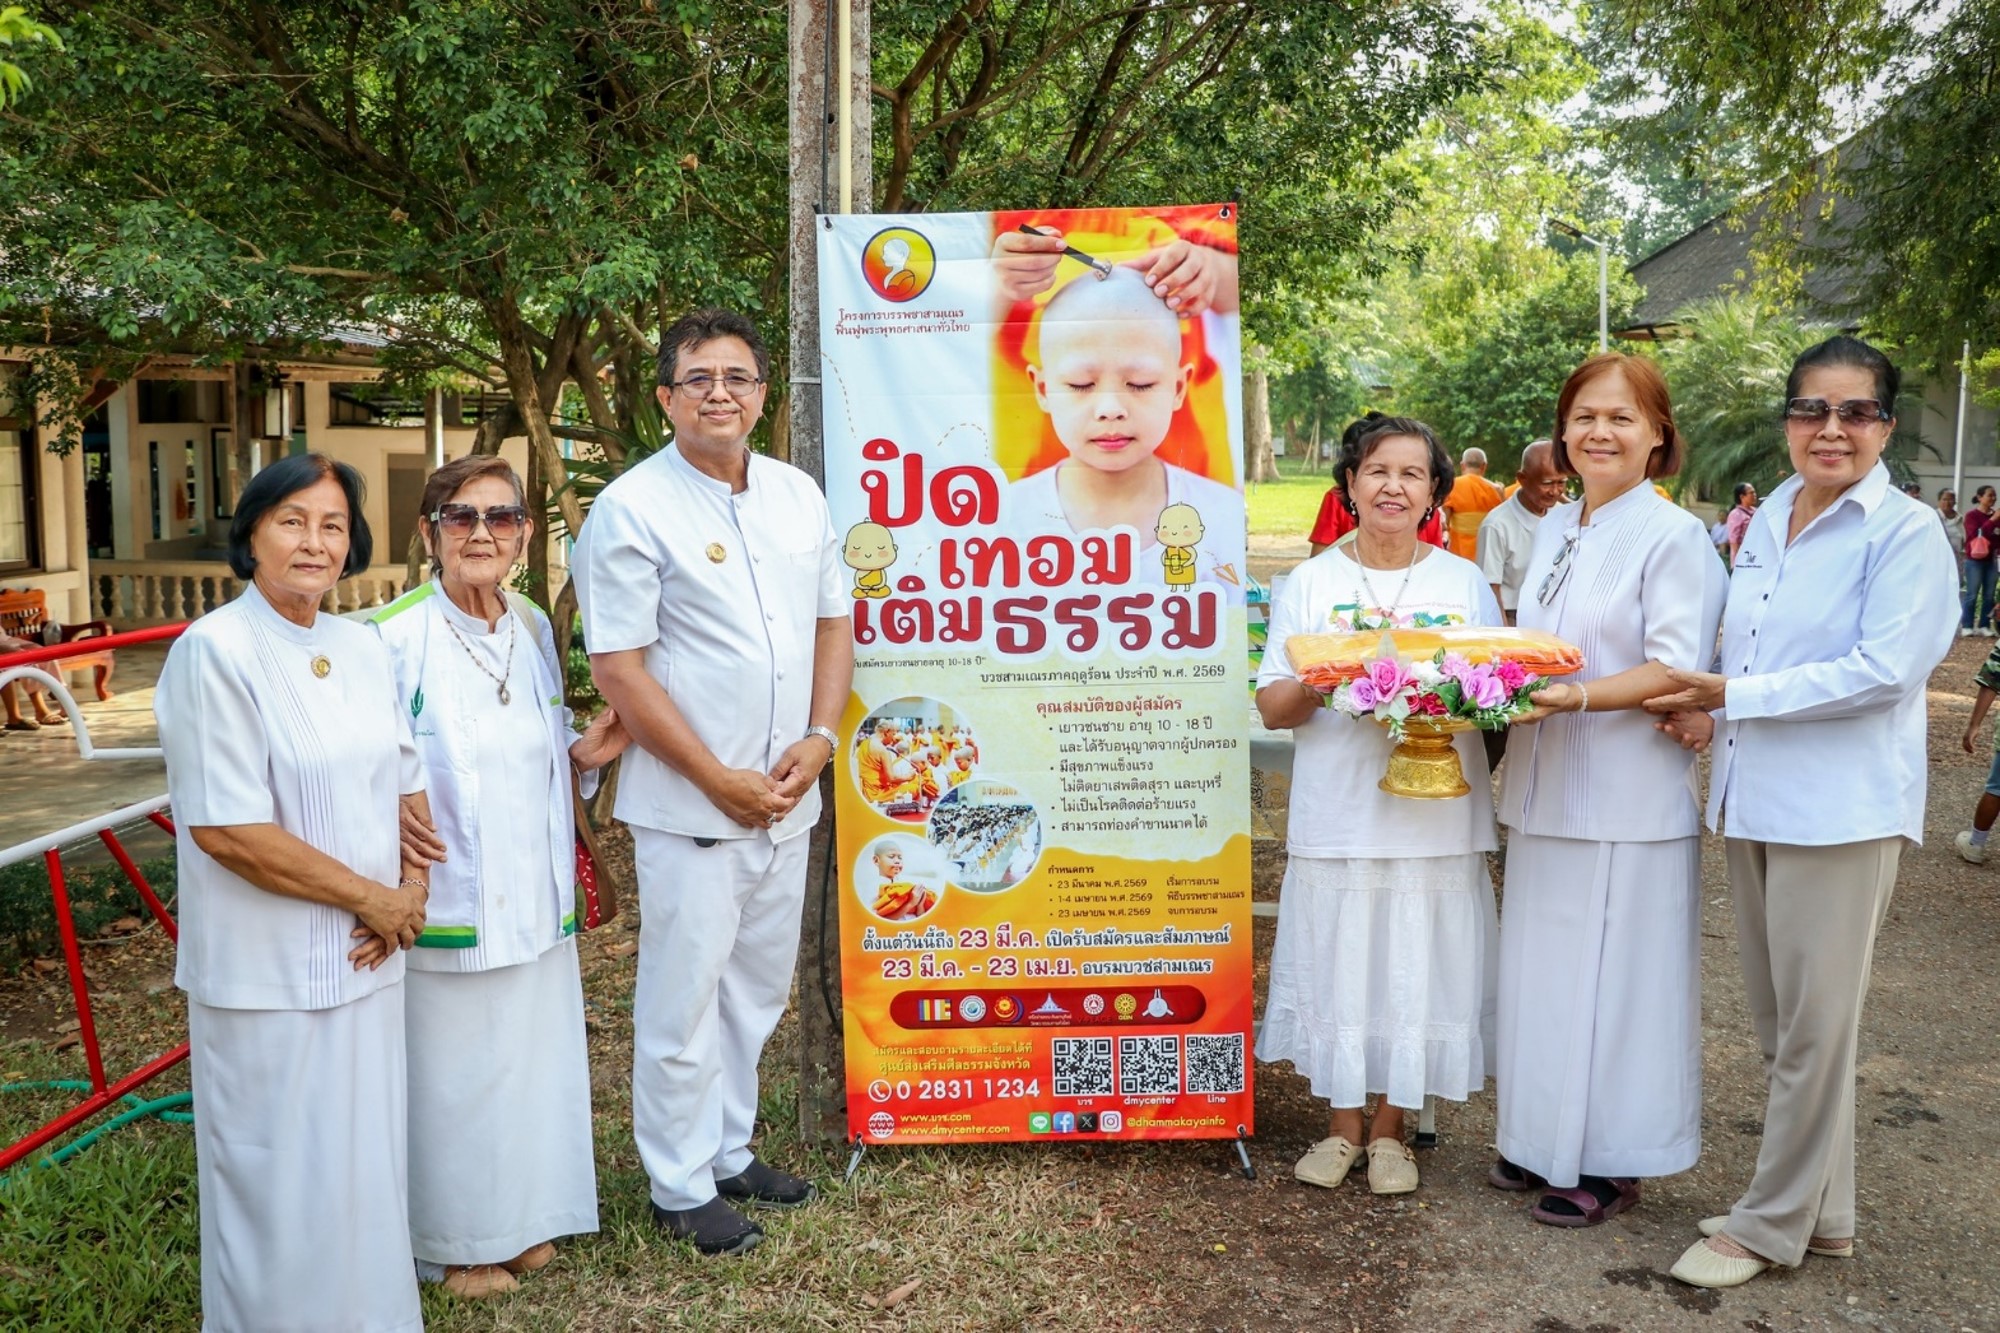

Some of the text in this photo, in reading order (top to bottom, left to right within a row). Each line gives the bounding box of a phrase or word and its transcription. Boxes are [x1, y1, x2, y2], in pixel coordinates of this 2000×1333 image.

[860, 438, 999, 528] ปิด
[939, 533, 1131, 589] เทอม
[948, 657, 972, 666] 10-18
[980, 665, 1225, 685] บวชสามเณรภาคฤดูร้อน ประจำปี พ.ศ. 2569
[1036, 695, 1182, 717] คุณสมบัติของผู้สมัคร
[1059, 721, 1125, 733] เยาวชนชาย
[1129, 720, 1152, 734] อายุ
[1158, 719, 1171, 730] 10
[1186, 719, 1199, 730] 18
[1060, 757, 1154, 775] มีสุขภาพแข็งแรง
[1060, 772, 1222, 794] ไม่ติดยาเสพติดสุรา และบุหรี่
[1060, 796, 1196, 813] ไม่เป็นโรคติดต่อร้ายแรง
[1061, 813, 1208, 832] สามารถท่องคำขานนาคได้
[1048, 865, 1095, 875] กำหนดการ
[1057, 880, 1069, 889] 23
[1072, 878, 1102, 888] มีนาคม
[1166, 874, 1219, 887] เริ่มการอบรม
[1074, 895, 1107, 903] เมษายน
[1058, 909, 1070, 918] 23
[1072, 909, 1105, 918] เมษายน
[1168, 907, 1218, 915] จบการอบรม
[863, 925, 1230, 951] ตั้งแต่วันนี้ถึง 23 มี.ค. เปิดรับสมัครและสัมภาษณ์
[883, 960, 912, 978] 23
[919, 953, 964, 978] มี.ค.
[988, 958, 1017, 976] 23
[1026, 958, 1076, 976] เม.ย.
[1083, 959, 1212, 975] อบรมบวชสามเณร
[879, 1058, 1030, 1076] ศูนย์ส่งเสริมศีลธรรมจังหวัด
[896, 1078, 1040, 1100] 0 2831 1234
[1124, 1096, 1176, 1107] dmycenter
[1208, 1095, 1226, 1104] Line
[901, 1124, 1010, 1137] www.dmycenter.com
[1127, 1117, 1226, 1129] @dhammakayainfo
